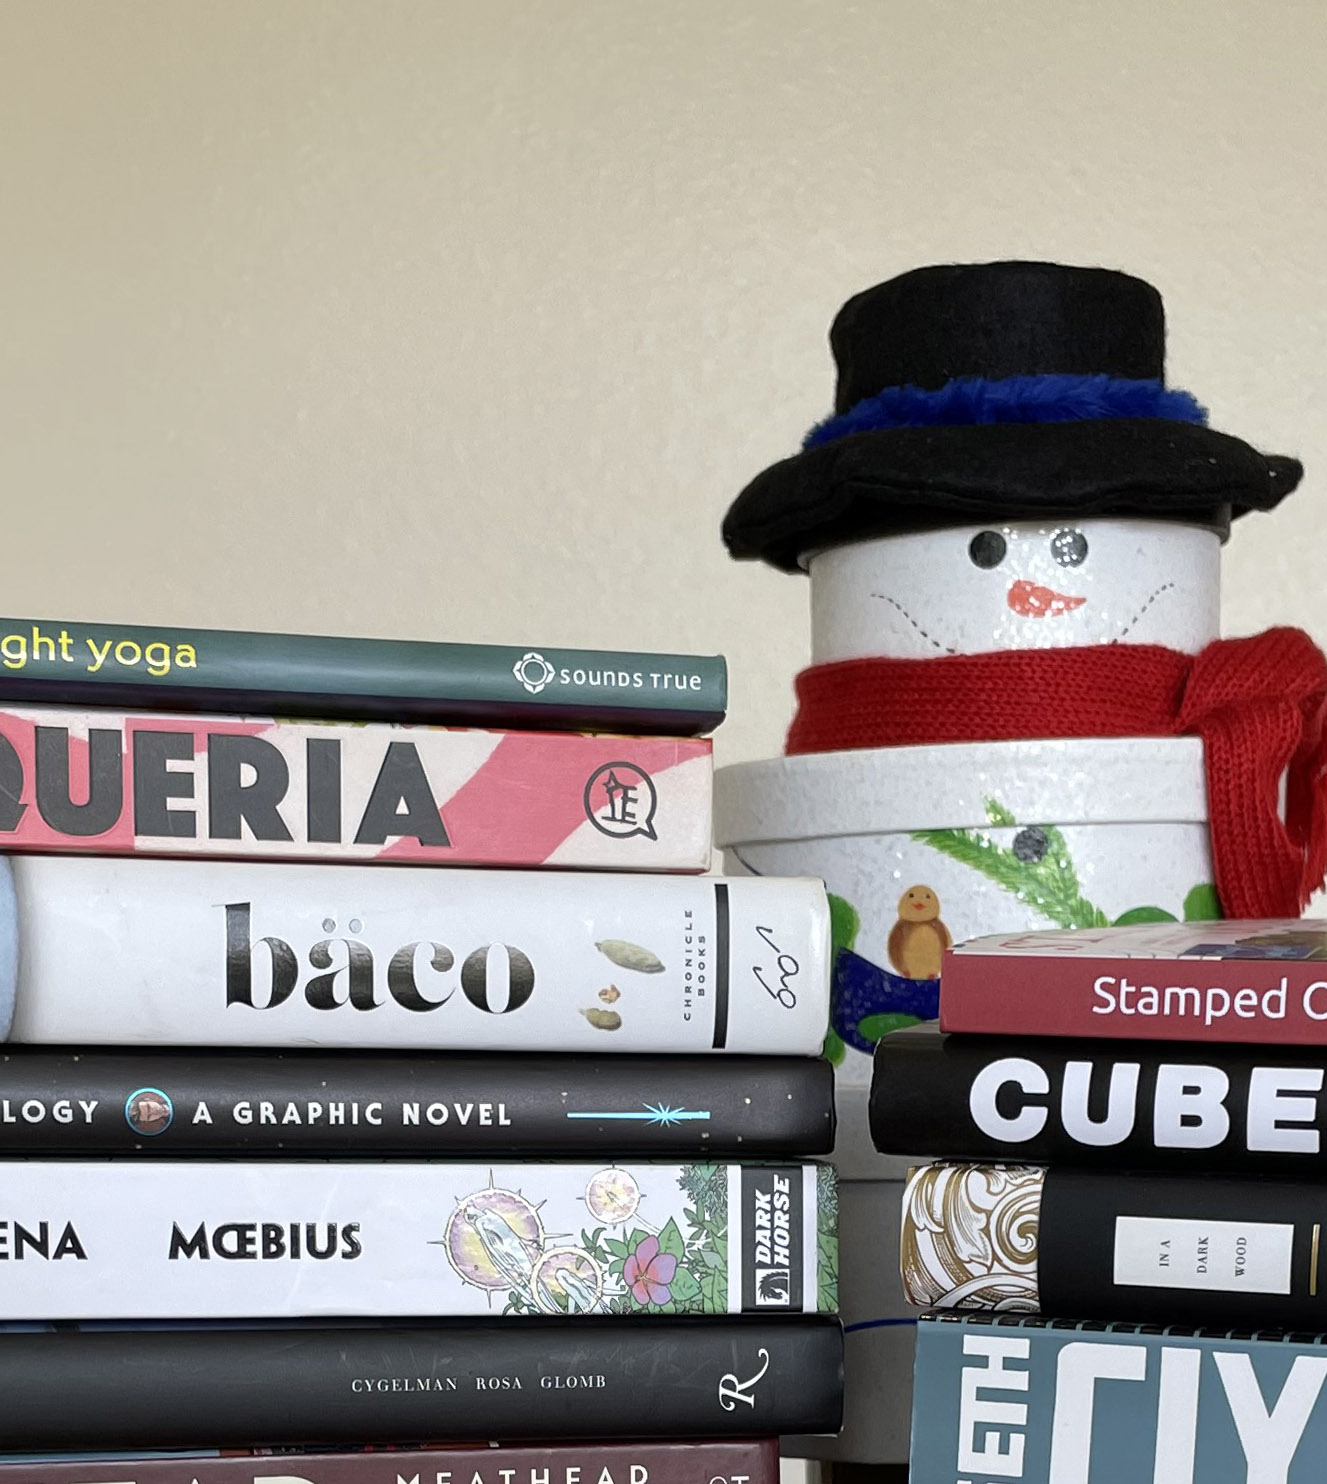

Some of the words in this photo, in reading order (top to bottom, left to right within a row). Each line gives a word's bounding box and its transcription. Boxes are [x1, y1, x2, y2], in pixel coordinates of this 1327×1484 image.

[85, 638, 197, 676] yoga
[212, 900, 535, 1014] bäco
[683, 910, 693, 1021] CHRONICLE
[697, 936, 706, 996] BOOKS
[1091, 976, 1288, 1025] Stamped
[192, 1101, 214, 1126] A
[233, 1100, 384, 1127] GRAPHIC
[402, 1101, 513, 1127] NOVEL
[755, 1188, 772, 1265] DARK
[773, 1174, 790, 1266] HORSE
[168, 1221, 362, 1261] MŒBIUS
[1159, 1253, 1170, 1267] IN
[1160, 1240, 1171, 1248] A
[1196, 1236, 1209, 1274] DARK
[1234, 1236, 1248, 1277] WOOD
[351, 1376, 459, 1394] CYGELMAN
[475, 1375, 523, 1391] ROSA
[540, 1374, 608, 1390] GLOMB
